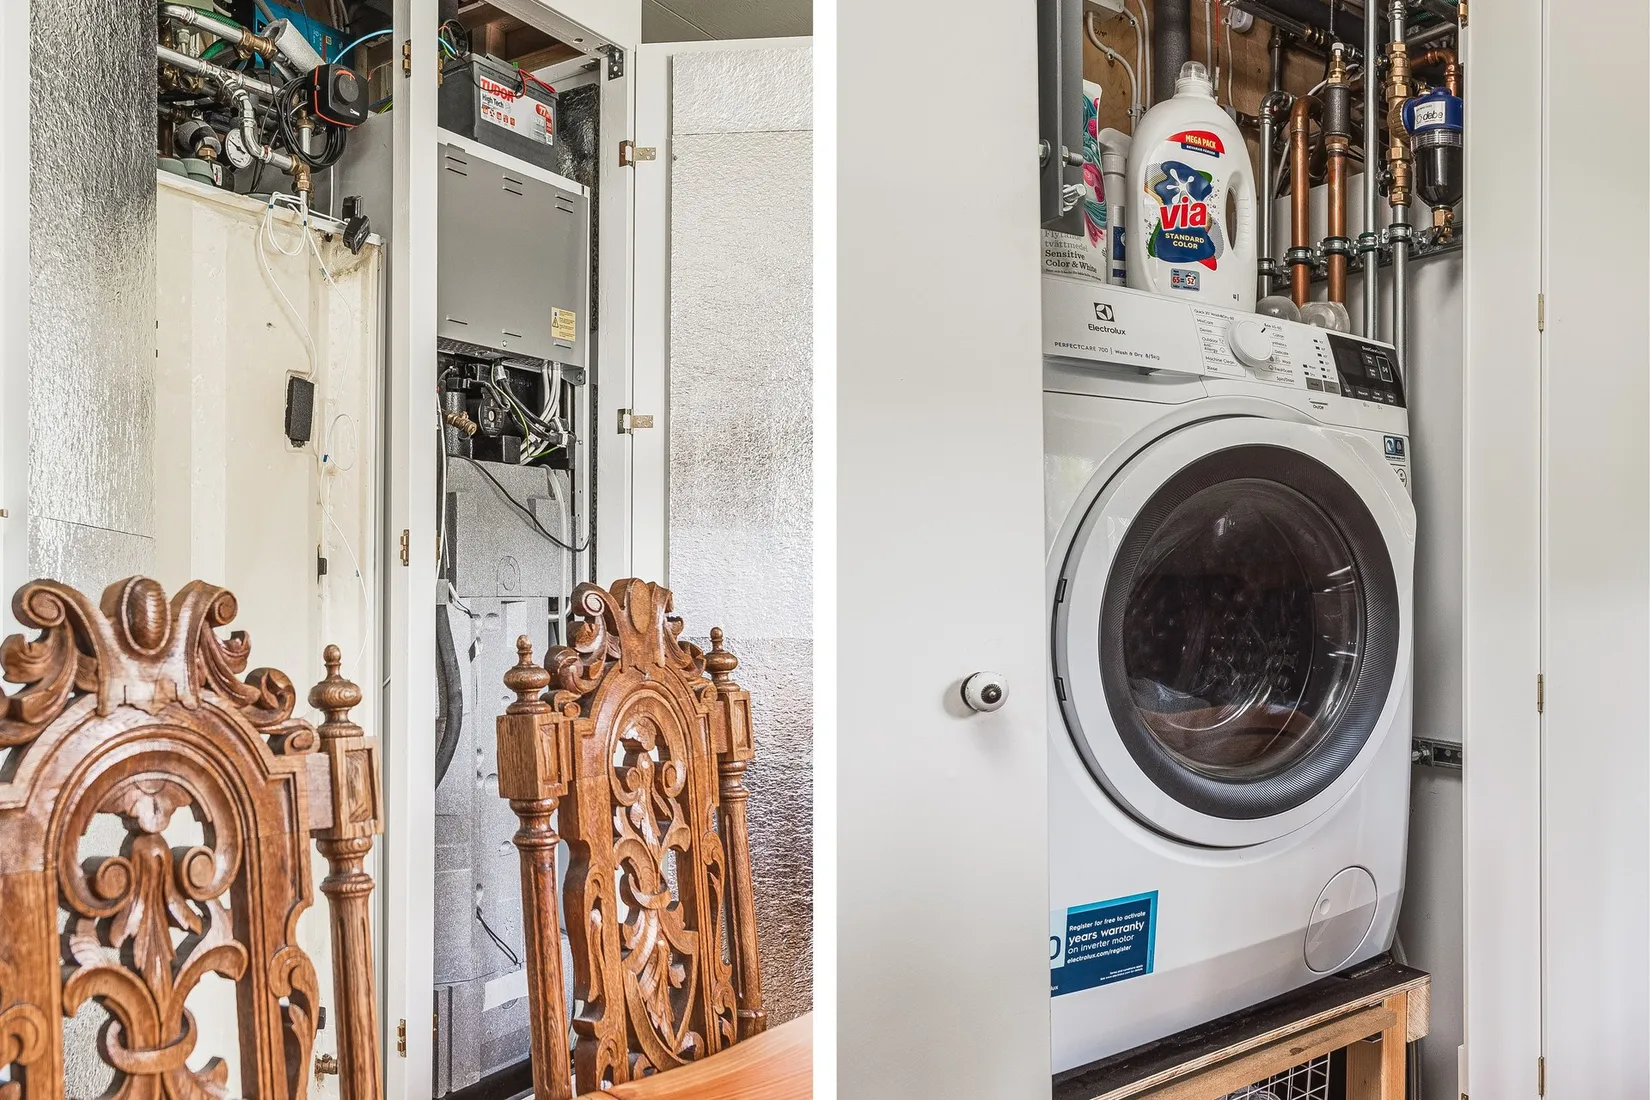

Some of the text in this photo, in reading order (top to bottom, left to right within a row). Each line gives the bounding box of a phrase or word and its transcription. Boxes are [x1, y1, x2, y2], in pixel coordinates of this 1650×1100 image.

[480, 78, 514, 103] TUDOR
[482, 93, 504, 108] High Tech
[1185, 134, 1217, 150] MEGA PACK
[1160, 196, 1207, 230] via
[1165, 232, 1205, 244] STANDARD
[1172, 240, 1198, 250] COLOR
[1045, 240, 1088, 252] tvättmedel
[1045, 249, 1085, 260] Sensitive
[1045, 259, 1098, 274] Color & White
[1172, 276, 1180, 284] 65
[1088, 323, 1126, 336] Electrolux
[1054, 341, 1097, 352] PERFECTCARE
[1069, 921, 1093, 932] Register
[1094, 918, 1103, 926] for
[1104, 916, 1116, 925] free
[1124, 911, 1146, 920] activate
[1068, 920, 1145, 946] years warranty
[1067, 934, 1135, 955] on inverter motor
[1067, 945, 1132, 964] electrolux.com/register
